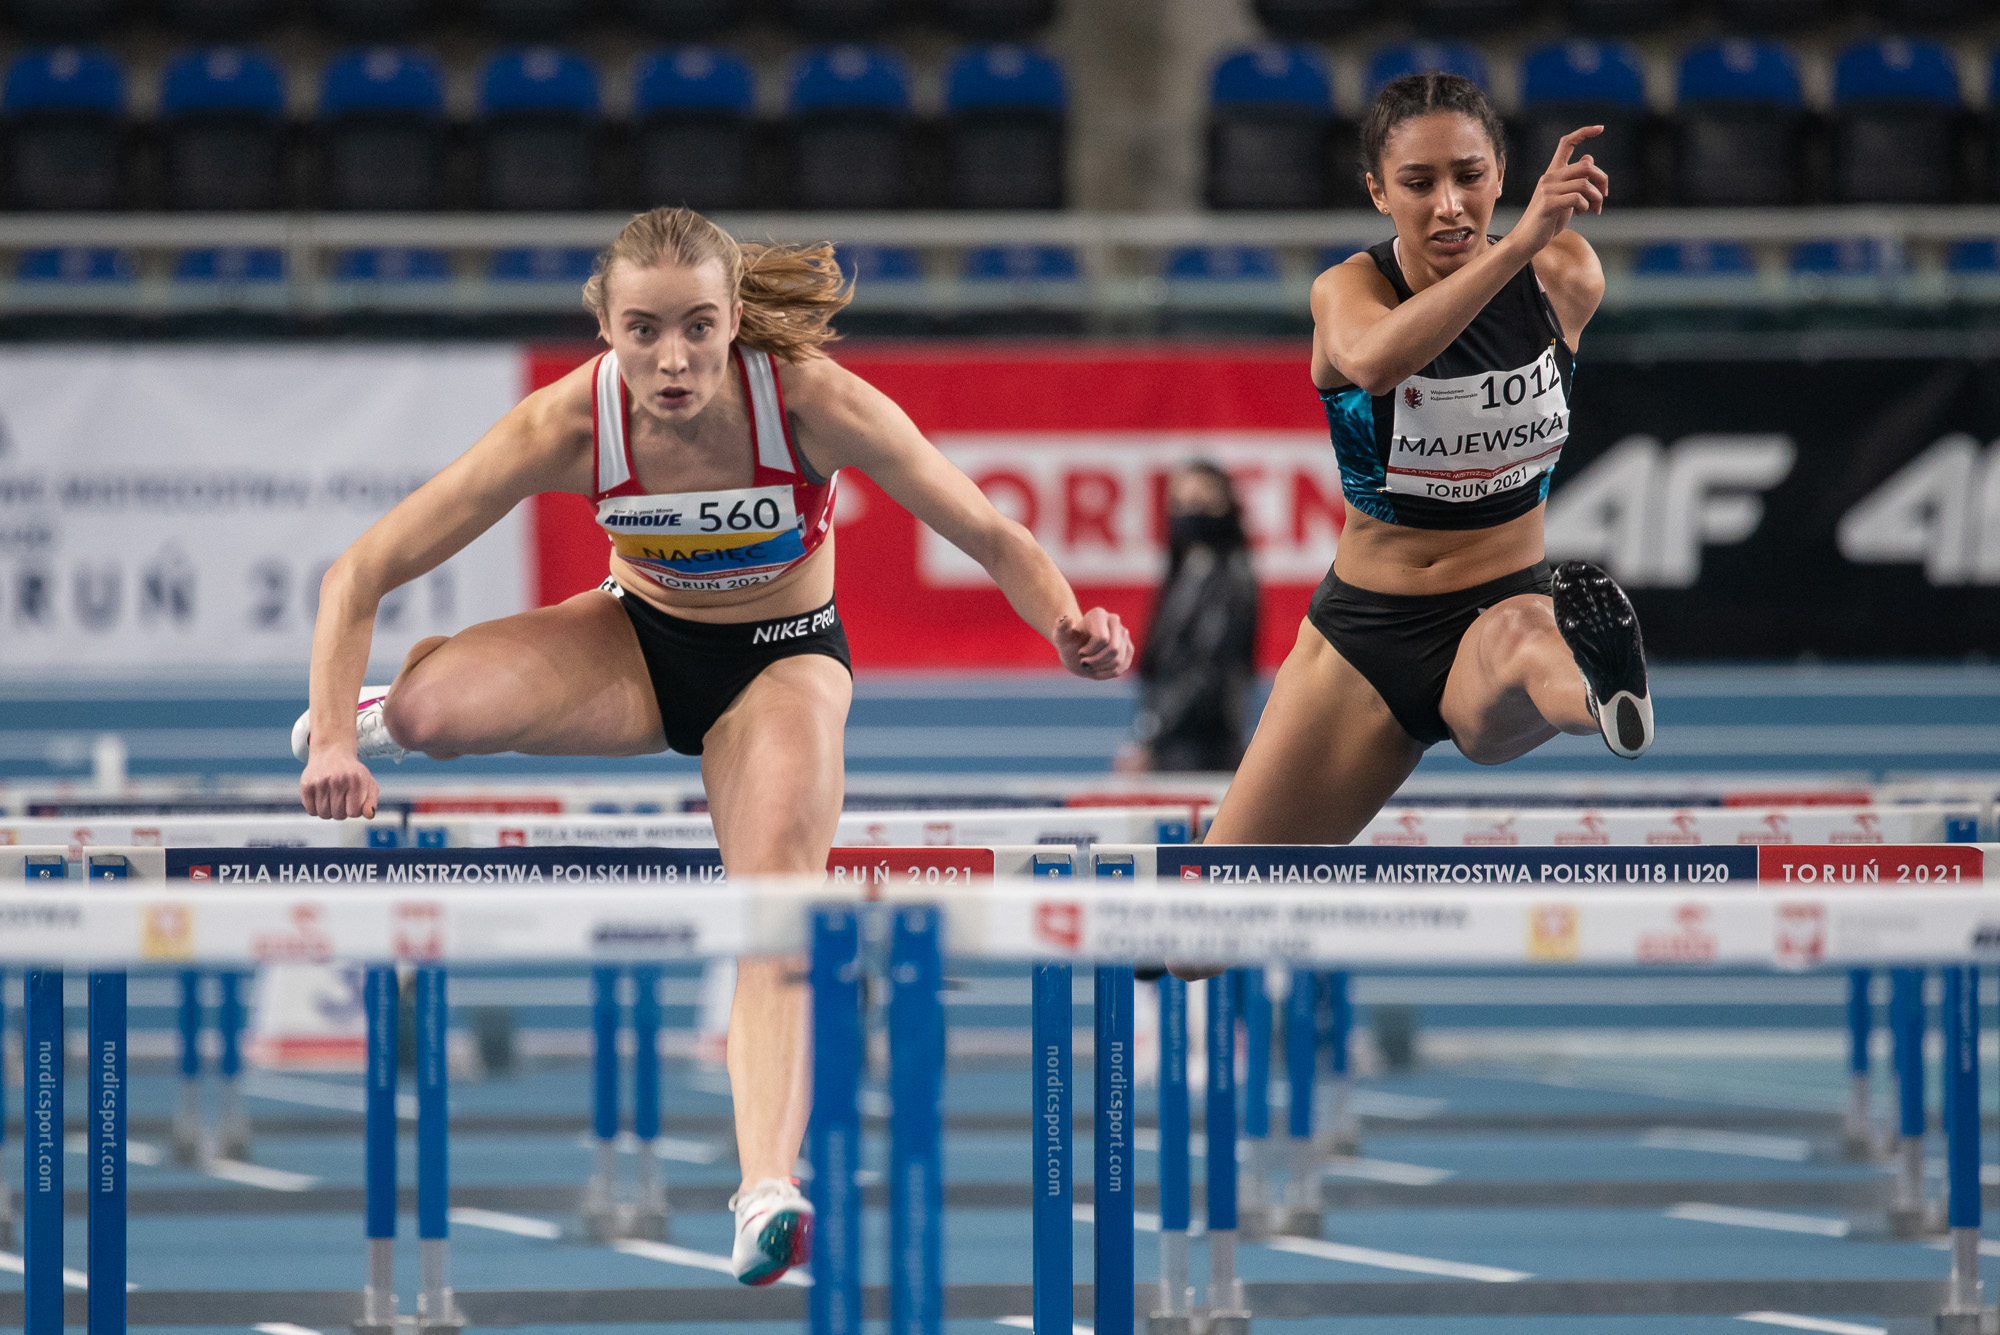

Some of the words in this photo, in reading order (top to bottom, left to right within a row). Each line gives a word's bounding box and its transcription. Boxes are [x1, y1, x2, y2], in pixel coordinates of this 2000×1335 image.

[1480, 353, 1561, 410] 1012
[1398, 411, 1564, 457] MAJEWSKA
[1426, 480, 1488, 498] TORUŃ
[1493, 466, 1527, 493] 2021
[700, 497, 780, 533] 560
[1545, 433, 1799, 589] 4F
[656, 574, 721, 590] TORUŃ
[726, 574, 771, 590] 2021
[752, 617, 810, 645] NIKE
[811, 604, 836, 634] PRO
[218, 864, 272, 884] PZLA
[279, 864, 377, 884] HALOWE
[385, 864, 544, 884] MISTRZOSTWA
[552, 864, 629, 884] POLSKI
[637, 864, 678, 884] U18
[685, 864, 691, 884] I
[699, 864, 727, 884] U2
[824, 859, 890, 885] RUŃ
[907, 866, 972, 886] 2021
[1209, 864, 1262, 884] PZLA
[1269, 864, 1367, 884] HALOWE
[1375, 864, 1533, 884] MISTRZOSTWA
[1540, 864, 1617, 884] POLSKI
[1625, 864, 1667, 884] U18
[1674, 864, 1680, 884] I
[1687, 864, 1730, 884] U20
[1782, 858, 1879, 884] TORUŃ
[1896, 865, 1961, 884] 2021
[34, 1041, 56, 1193] nordicsport.com
[98, 1041, 120, 1193] nordicsport.com
[1043, 1045, 1064, 1197] nordicsport.com
[1106, 1041, 1128, 1193] nordicsport.com
